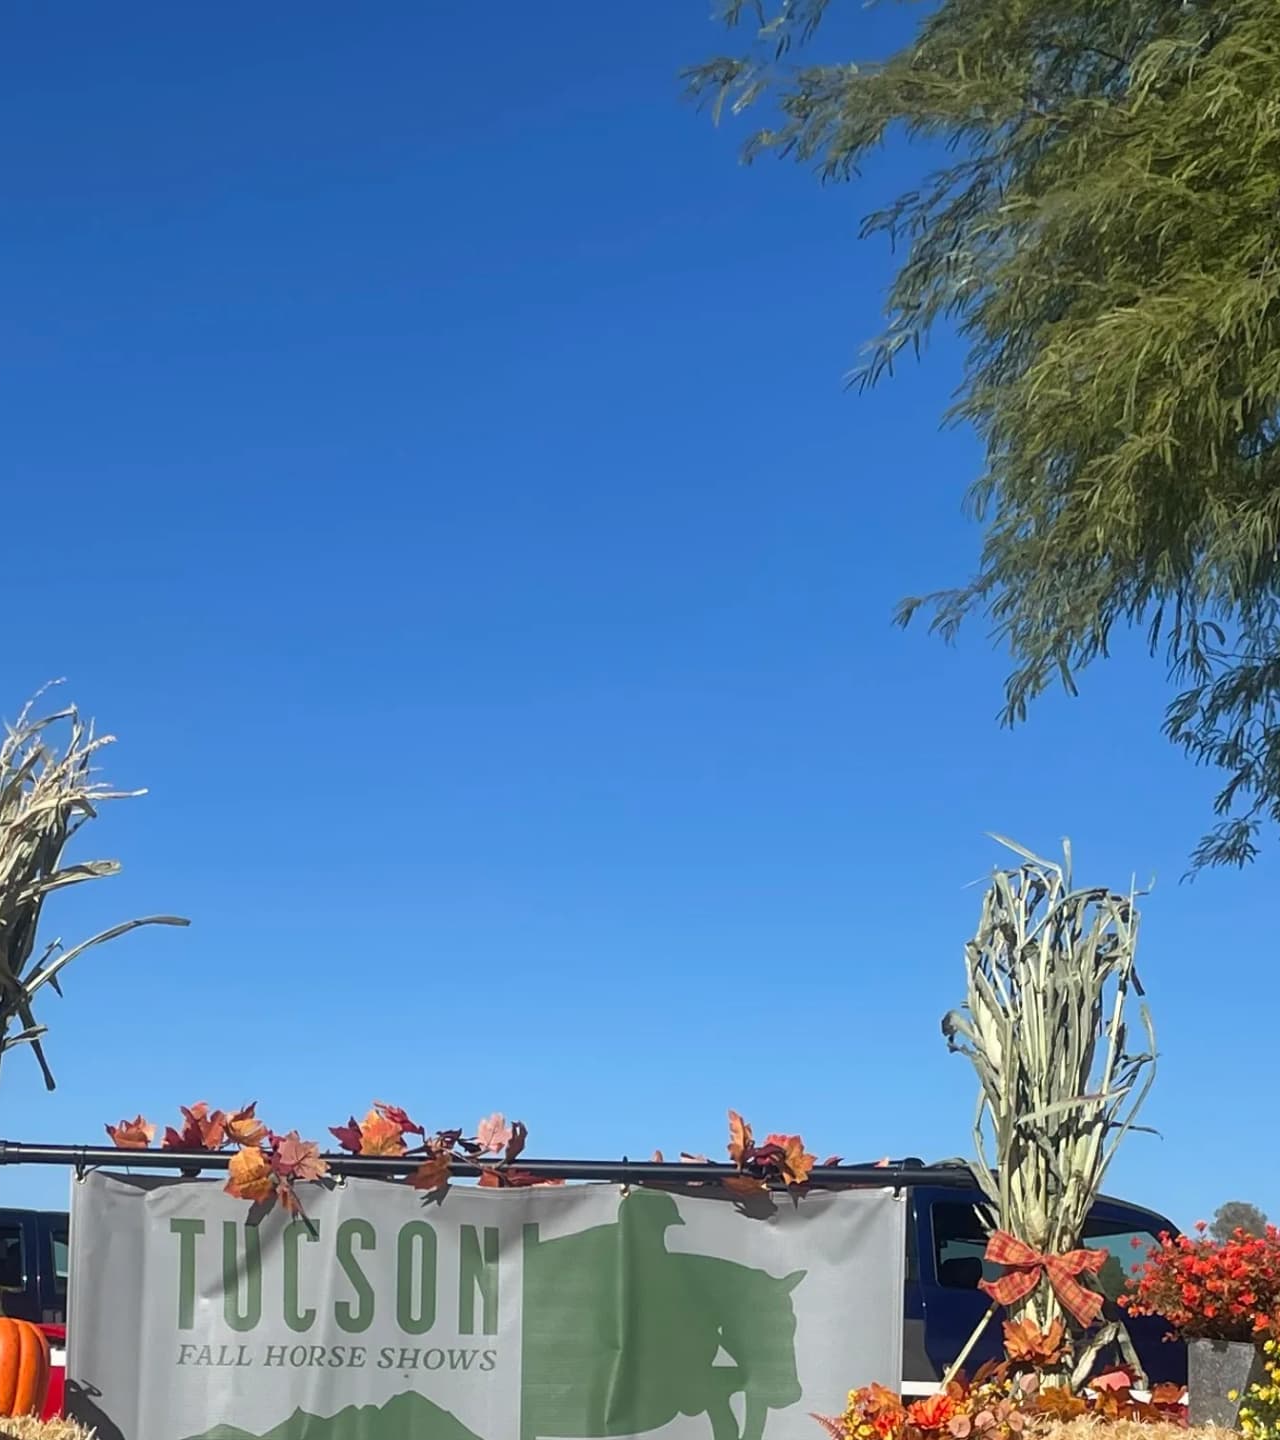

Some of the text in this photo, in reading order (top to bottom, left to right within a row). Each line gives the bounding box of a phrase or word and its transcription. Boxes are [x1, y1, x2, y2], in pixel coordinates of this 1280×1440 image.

[170, 1218, 499, 1335] TUCSON
[176, 1344, 497, 1371] FALL HORSE SHOWS
